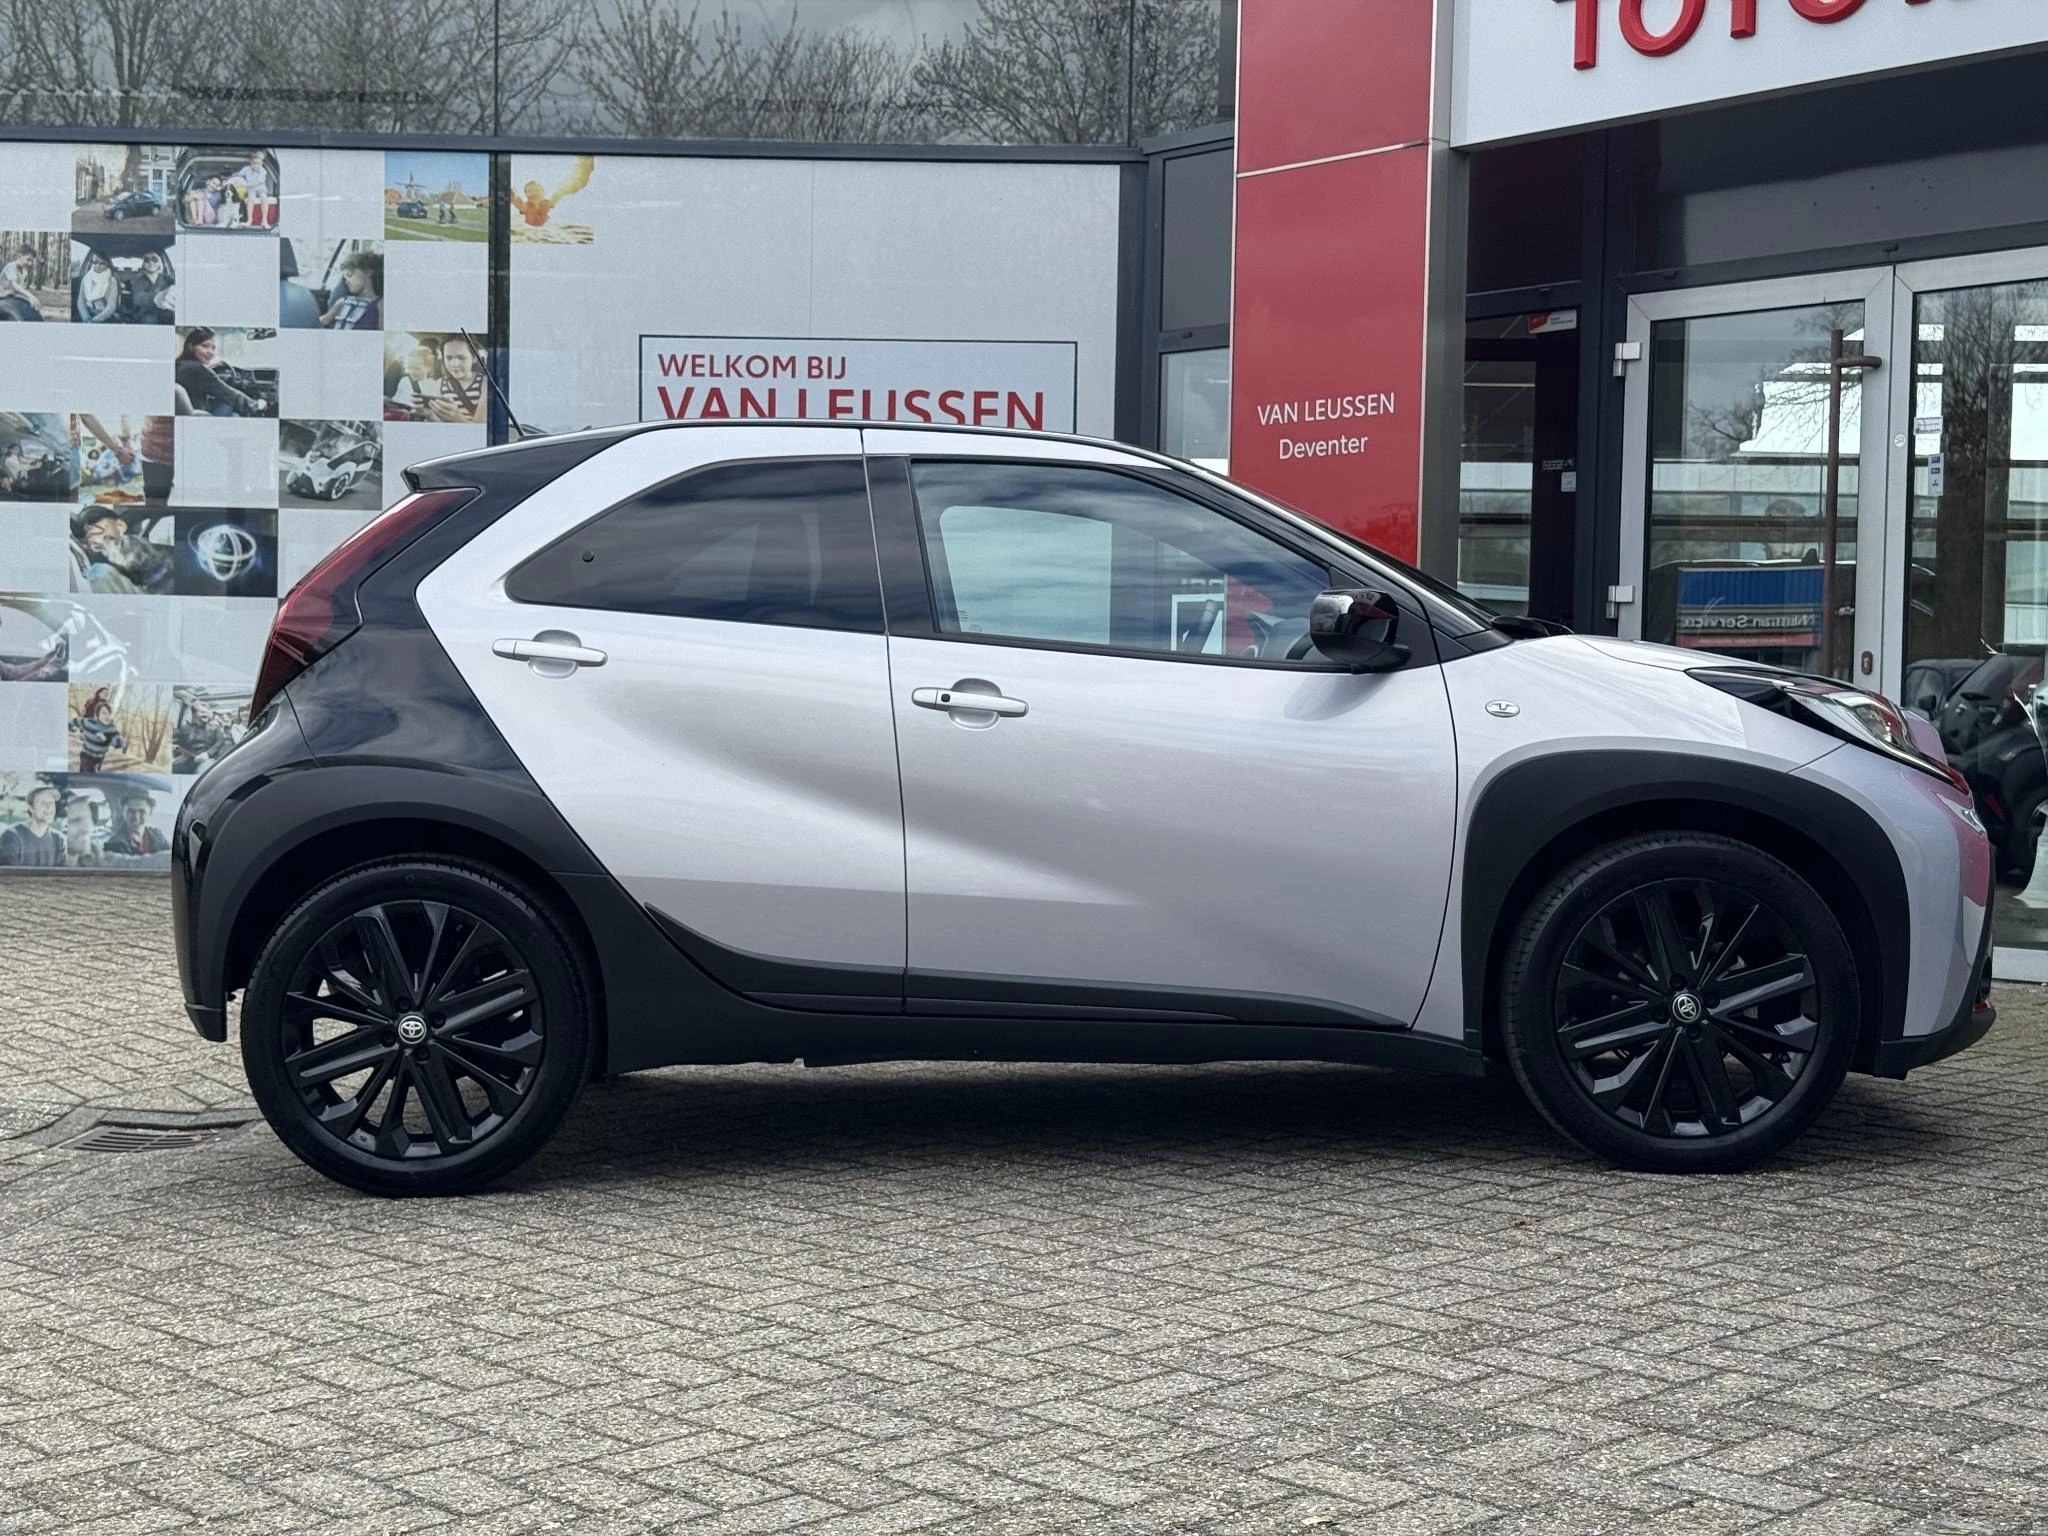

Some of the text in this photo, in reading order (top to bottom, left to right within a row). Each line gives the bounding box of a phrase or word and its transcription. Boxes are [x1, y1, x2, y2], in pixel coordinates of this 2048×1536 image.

[657, 353, 847, 381] WELKOM BIJ
[657, 386, 777, 420] VAN
[1256, 392, 1395, 426] VAN LEUSSEN
[1278, 434, 1369, 460] Deventer
